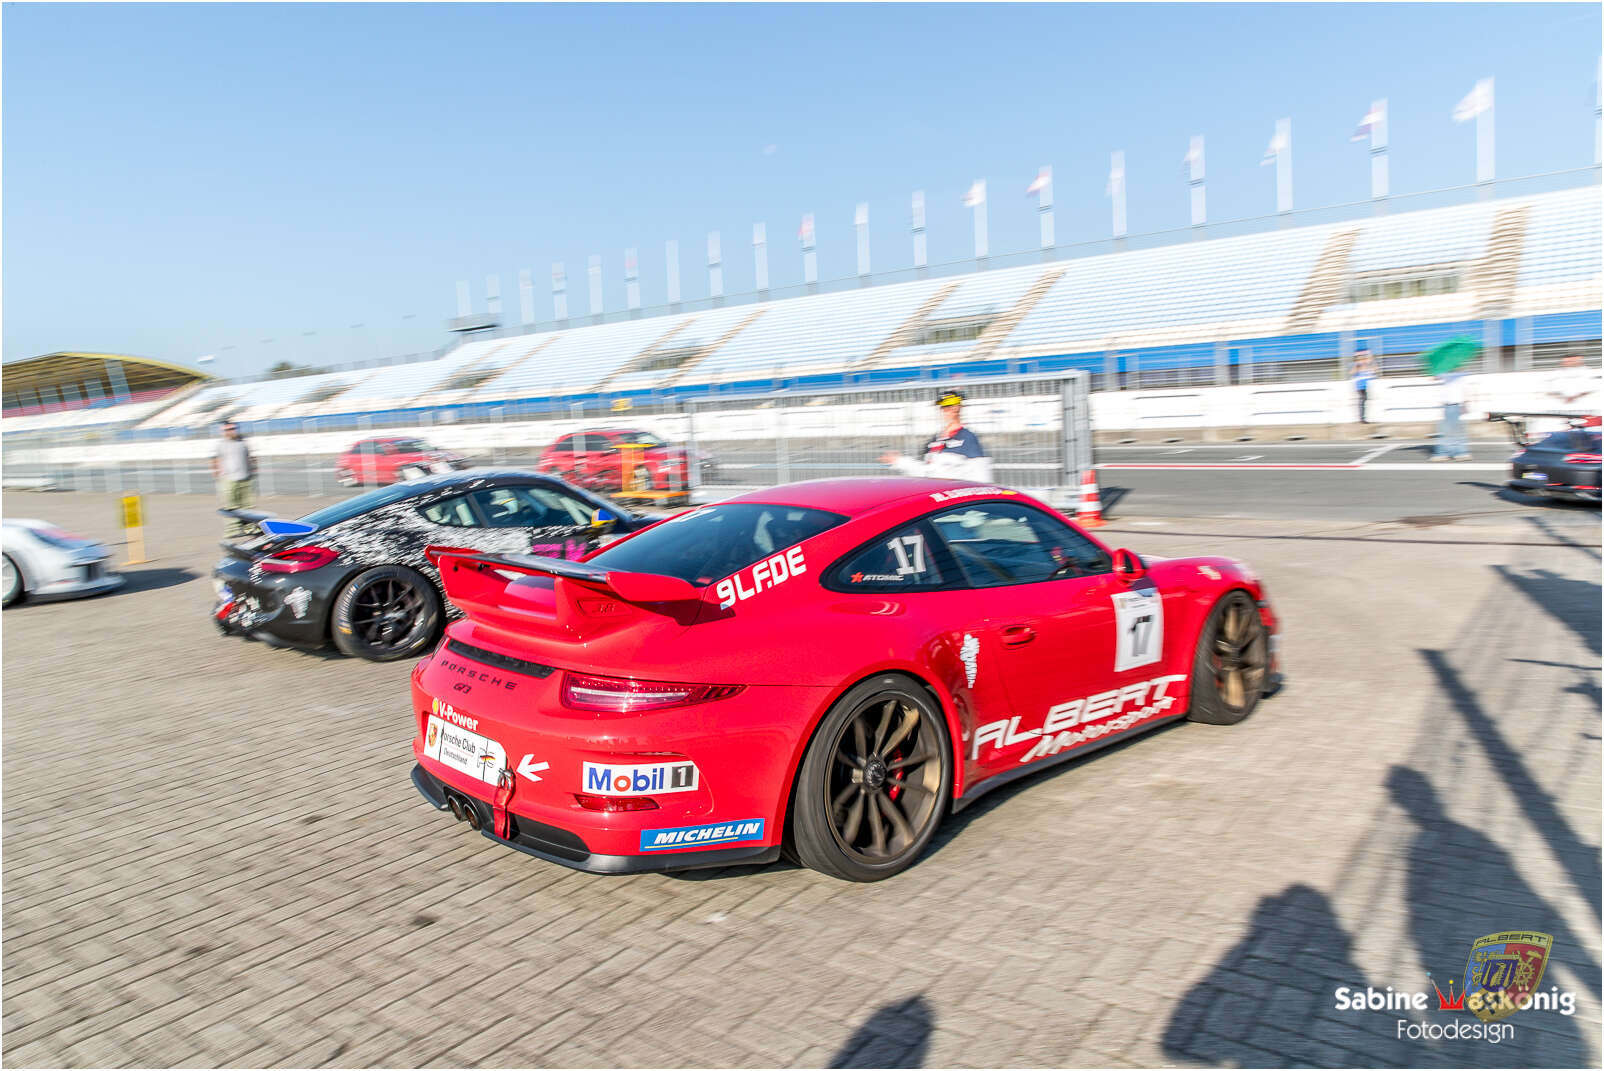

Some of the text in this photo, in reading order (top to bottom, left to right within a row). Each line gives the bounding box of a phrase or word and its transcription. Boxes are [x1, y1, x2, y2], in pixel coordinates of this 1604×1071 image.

[887, 534, 926, 575] 17
[716, 545, 807, 611] 9LF.DE
[1128, 614, 1154, 657] 17
[440, 659, 518, 690] PORSCHE
[439, 701, 479, 731] V-Power
[971, 674, 1188, 760] ALBERT
[442, 732, 476, 754] orsche Club
[588, 767, 665, 792] Mobil
[653, 822, 761, 845] MICHELIN
